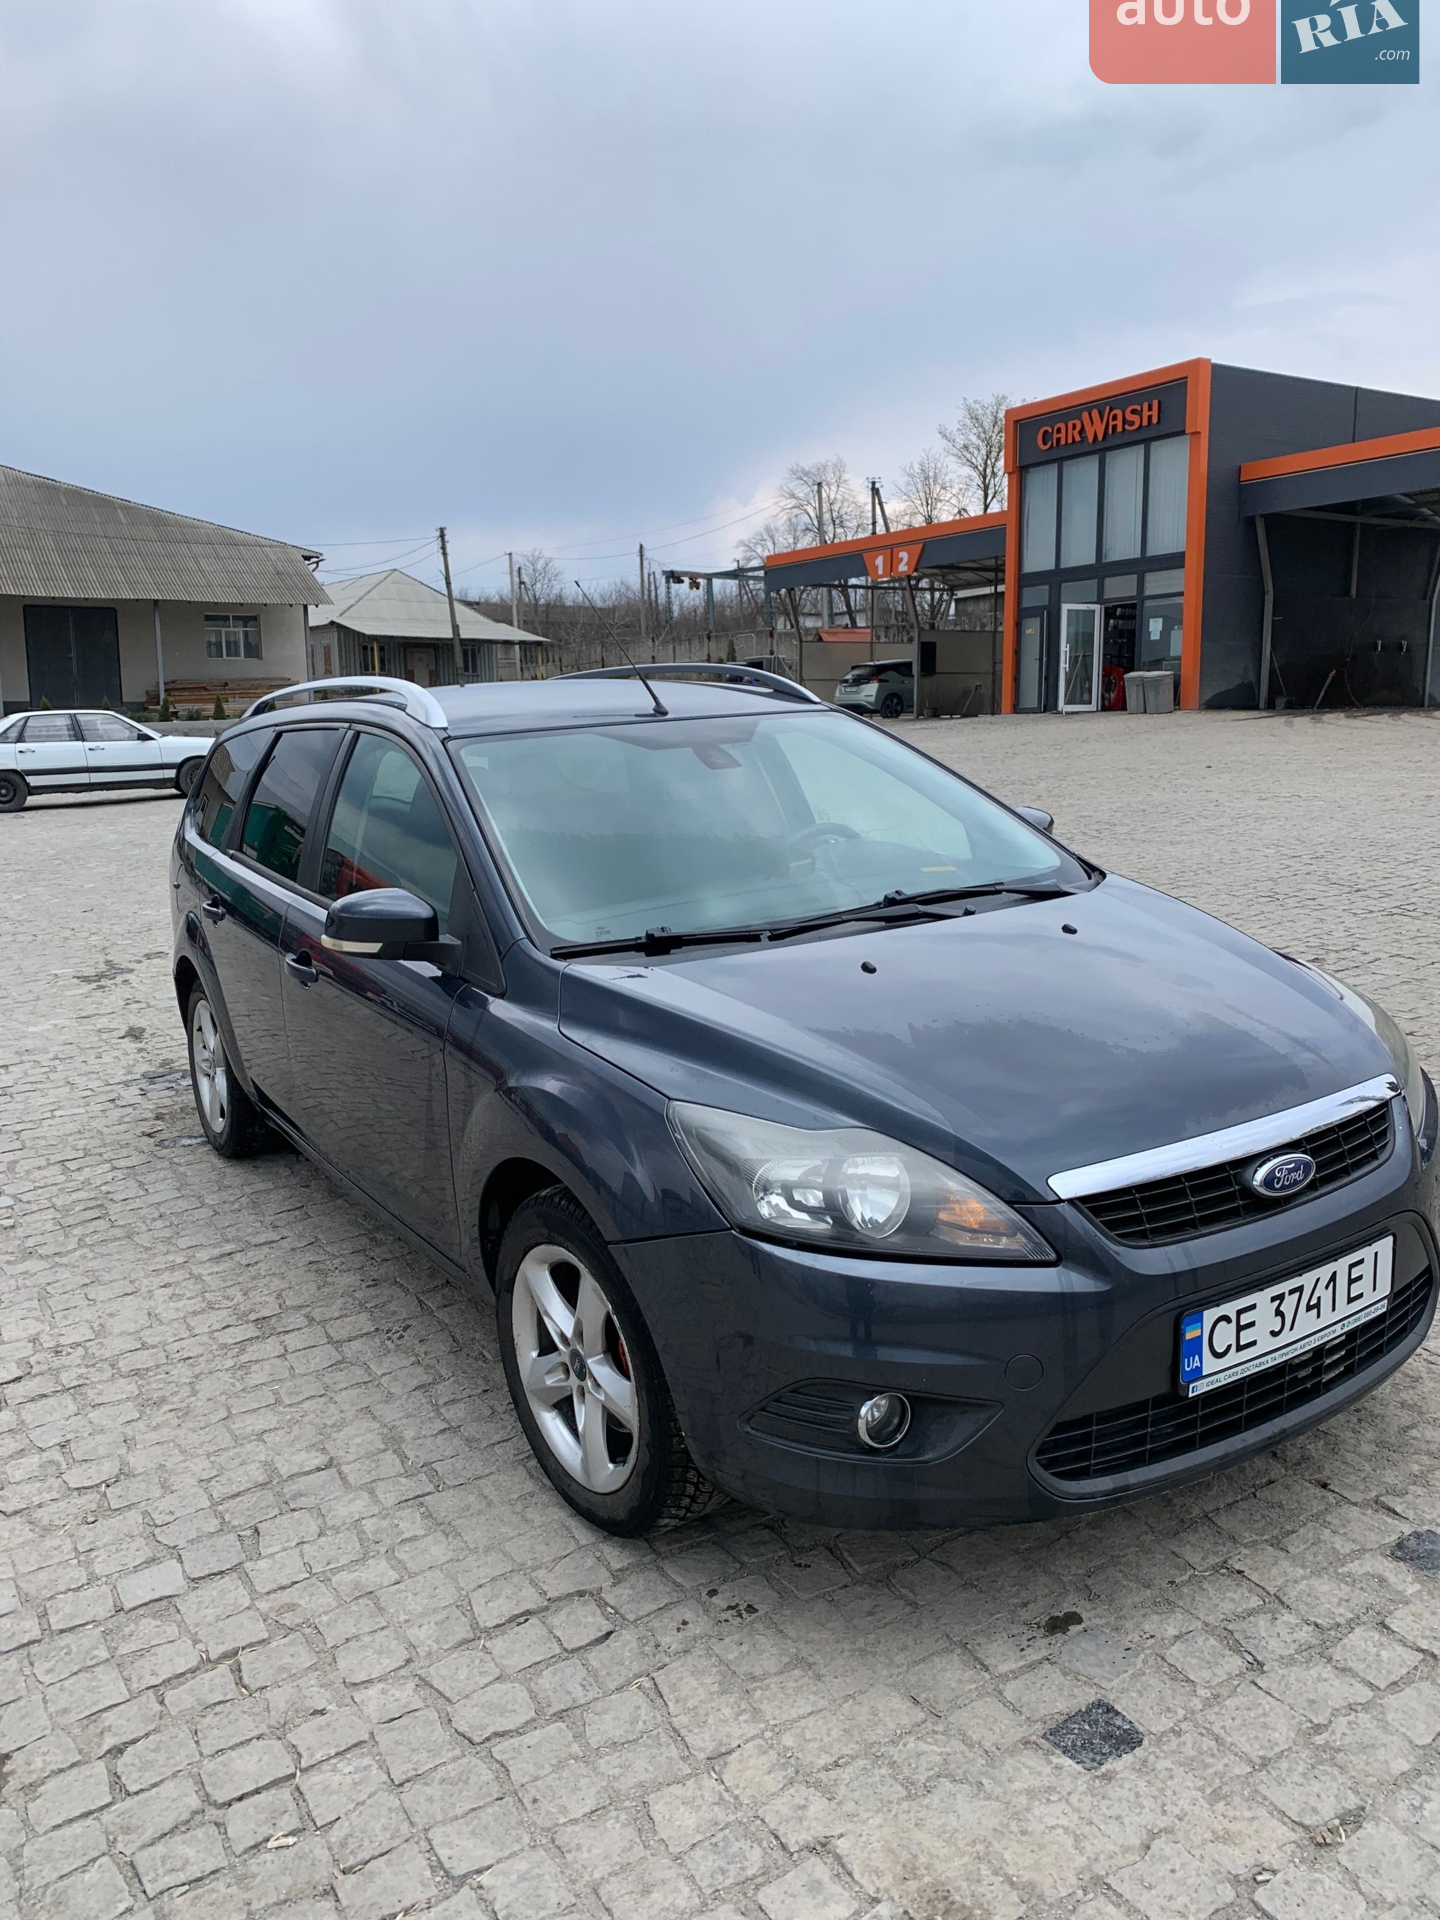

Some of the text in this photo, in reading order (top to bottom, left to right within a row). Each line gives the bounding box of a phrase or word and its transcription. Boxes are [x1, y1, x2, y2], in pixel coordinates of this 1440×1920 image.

[1037, 399, 1160, 450] CARWASH
[874, 551, 909, 575] 1 2
[1274, 1163, 1305, 1188] Ford
[1208, 1303, 1258, 1359] CE
[1269, 1270, 1338, 1338] 3741
[1184, 1354, 1201, 1371] UA
[1223, 1370, 1239, 1381] CARS
[1240, 1359, 1269, 1375] ДОСТАВКА
[1299, 1340, 1312, 1350] АВТО
